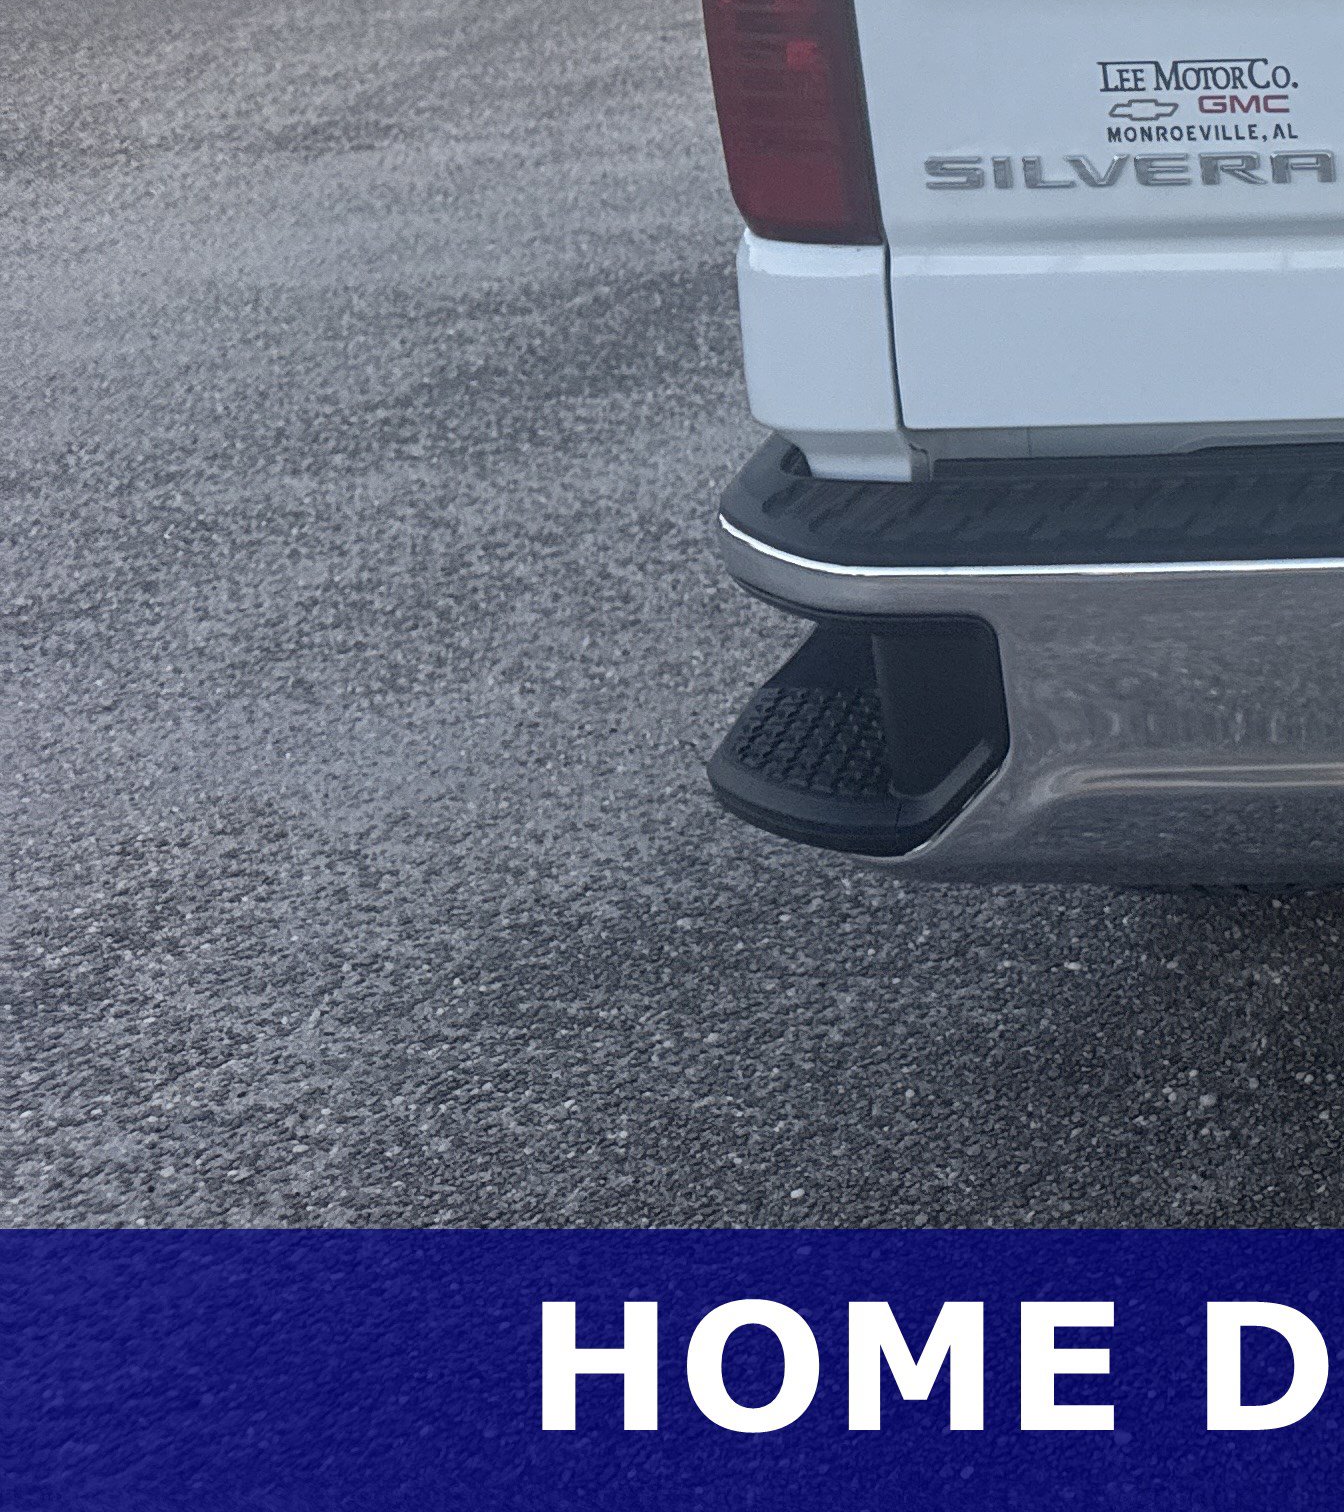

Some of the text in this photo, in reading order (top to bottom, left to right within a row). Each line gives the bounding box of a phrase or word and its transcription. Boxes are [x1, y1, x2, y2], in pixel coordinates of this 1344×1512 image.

[1097, 58, 1299, 92] LEE MOTOR CO.
[1198, 94, 1290, 114] GMC
[1107, 122, 1299, 143] MONROEVILLE, AL
